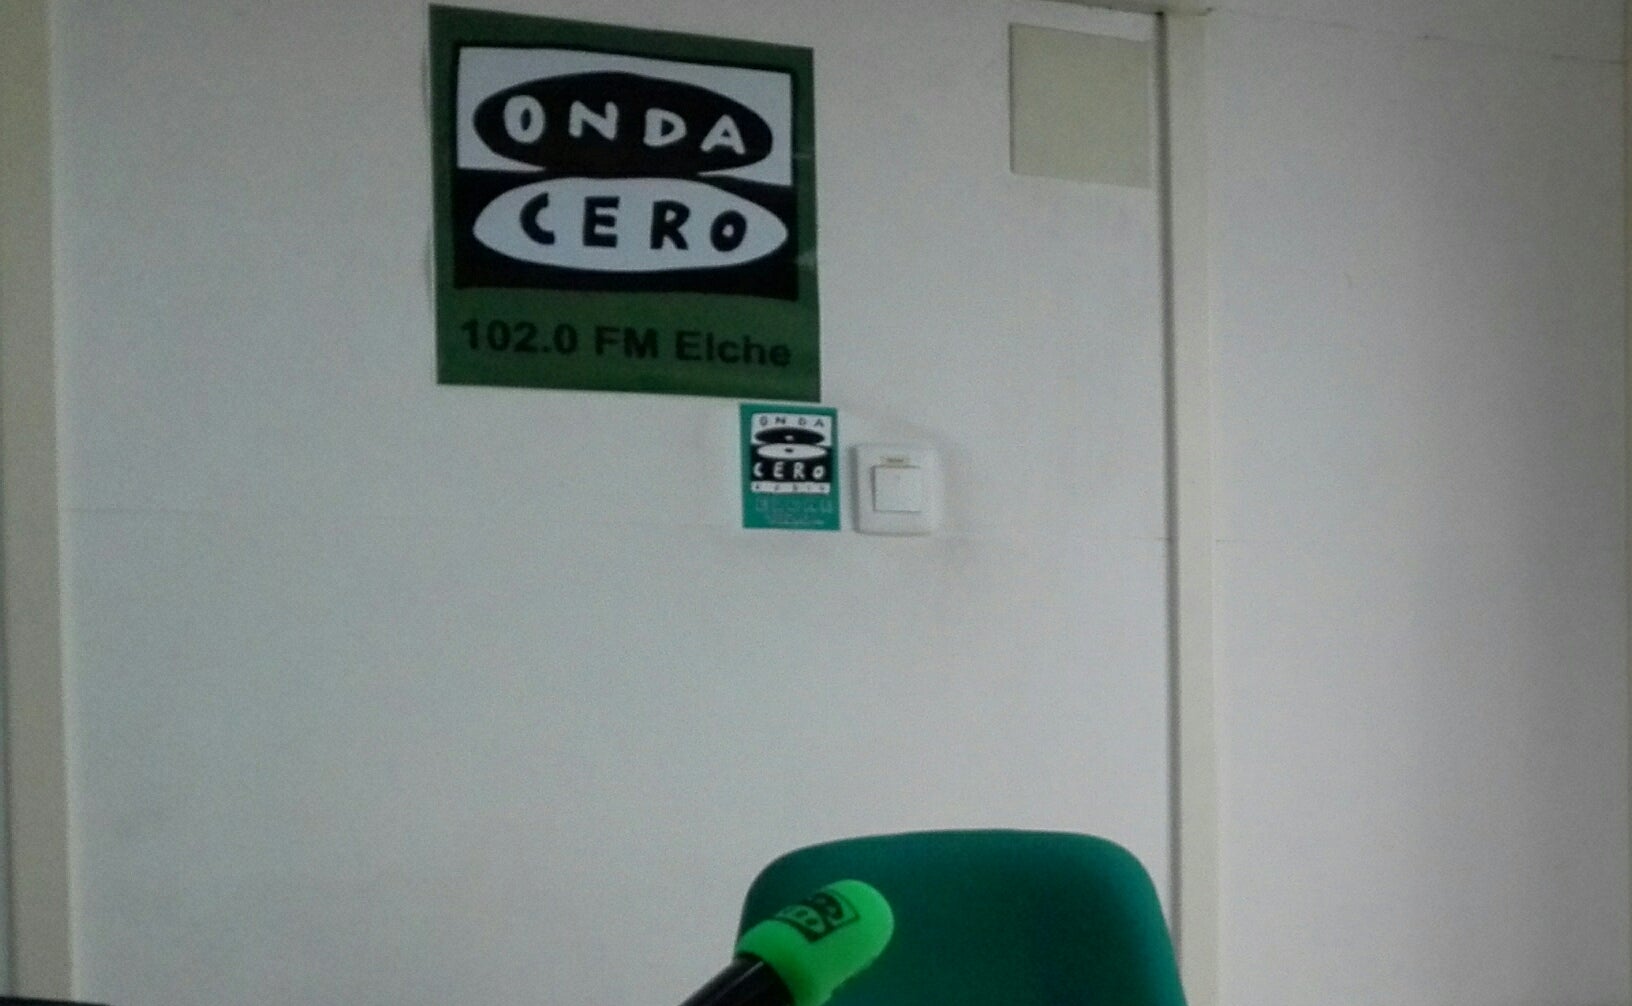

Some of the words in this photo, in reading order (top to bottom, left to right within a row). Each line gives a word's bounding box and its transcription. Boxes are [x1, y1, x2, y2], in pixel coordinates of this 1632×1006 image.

[503, 94, 747, 156] ONDA
[519, 192, 748, 253] CERO
[460, 318, 579, 356] 102.0
[594, 325, 659, 359] FM
[675, 330, 792, 367] Elche
[758, 415, 825, 427] ONDA
[753, 461, 826, 480] CERO
